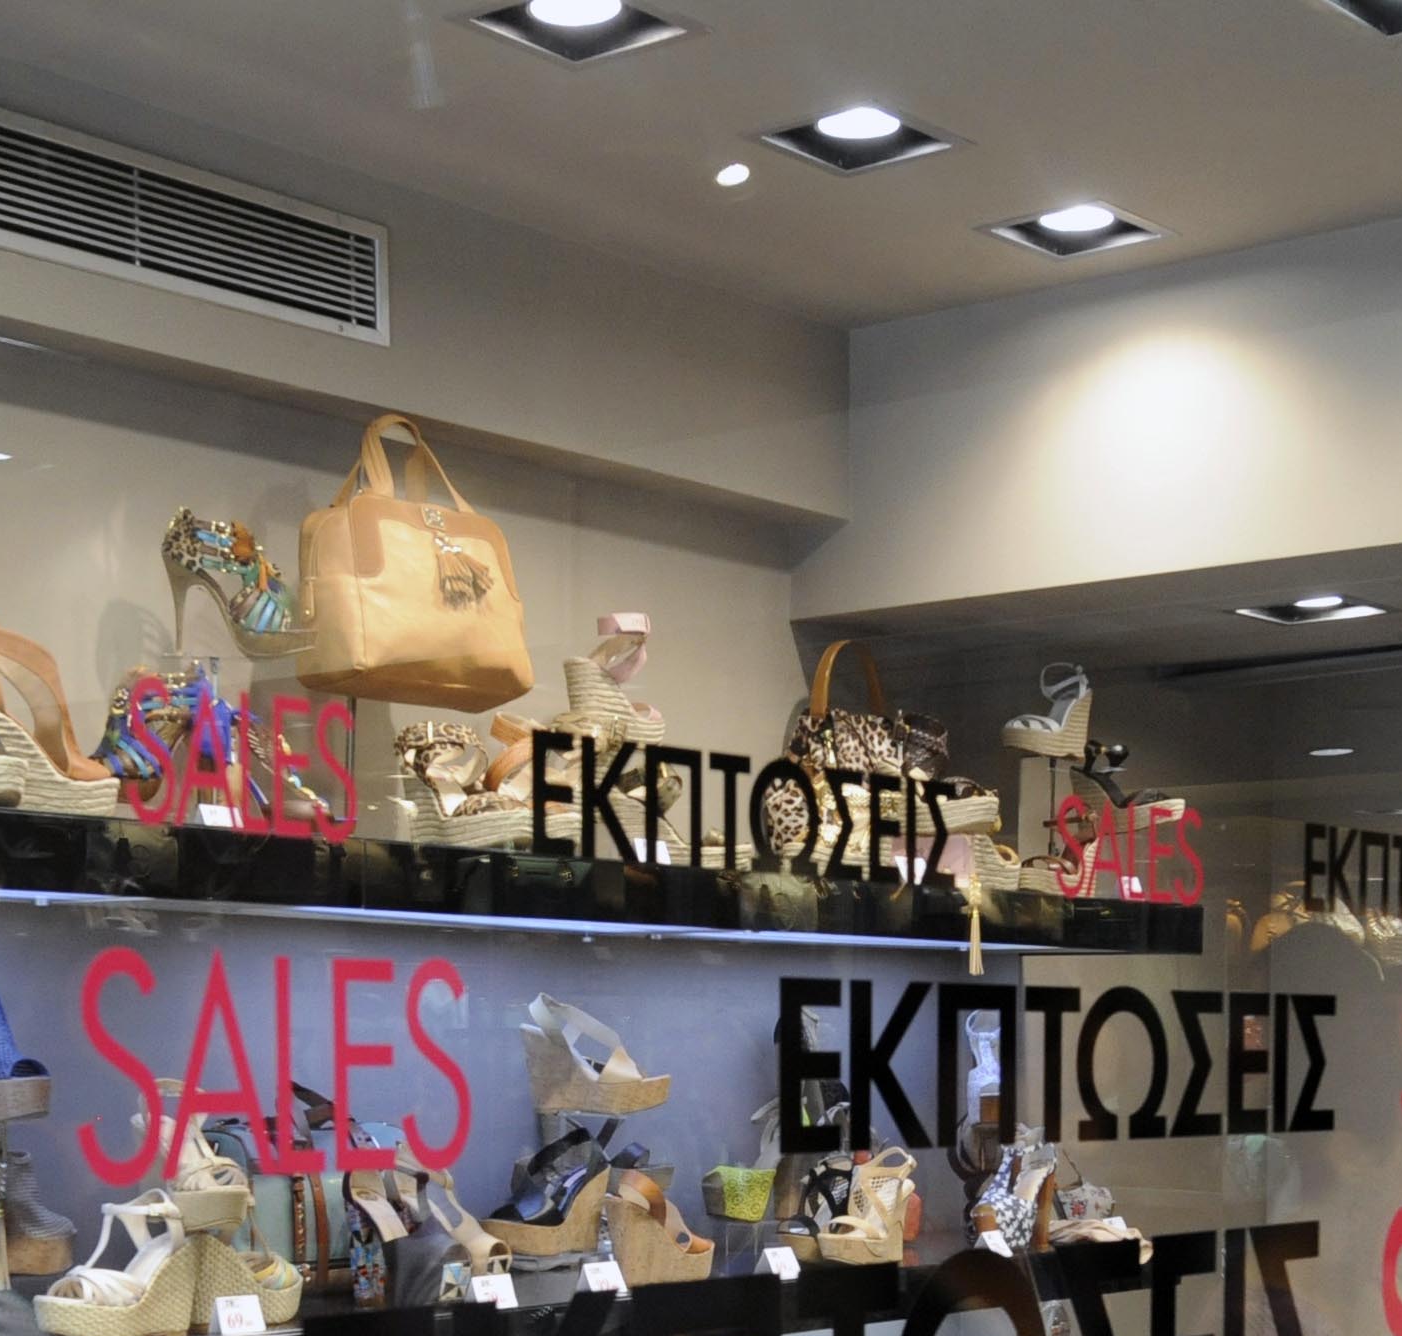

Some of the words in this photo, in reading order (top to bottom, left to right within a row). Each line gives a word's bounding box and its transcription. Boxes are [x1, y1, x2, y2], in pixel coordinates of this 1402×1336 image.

[127, 673, 356, 843] SALES
[532, 729, 960, 889] ΕΚΠΤΩΣΕΙΣ
[1054, 794, 1204, 907] SALES
[79, 946, 473, 1188] SALES
[779, 977, 1336, 1155] ΕΚΠΤΩΣΕΙΣ
